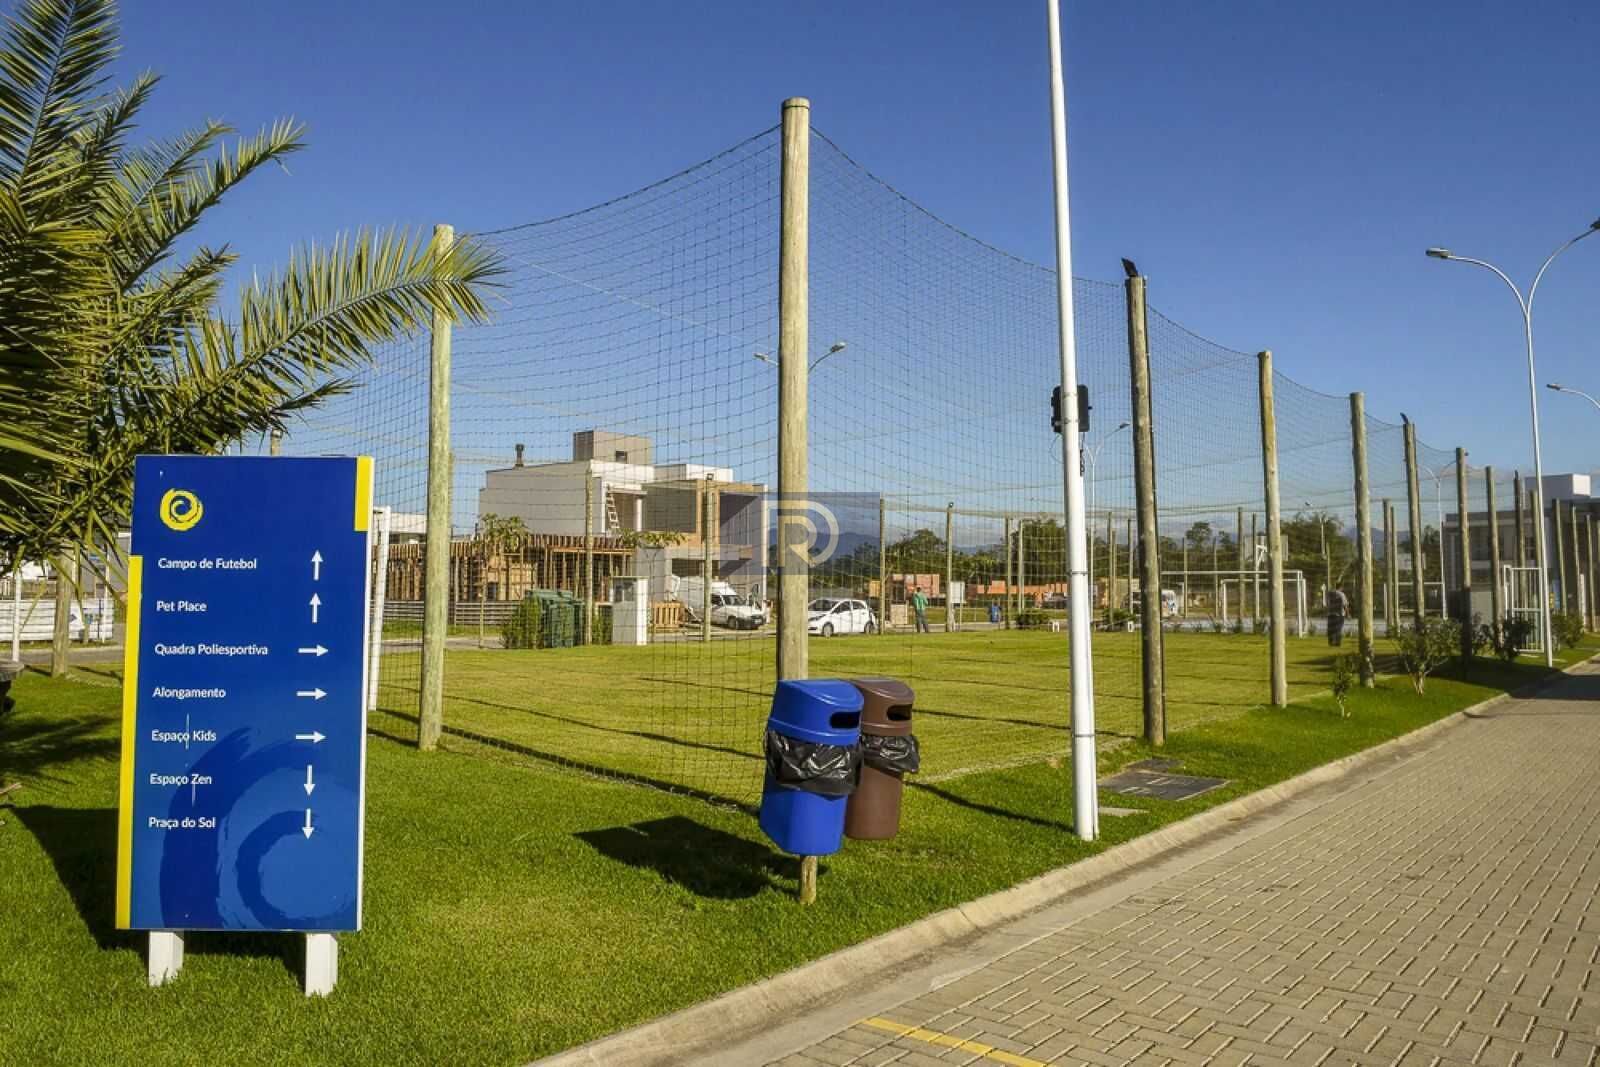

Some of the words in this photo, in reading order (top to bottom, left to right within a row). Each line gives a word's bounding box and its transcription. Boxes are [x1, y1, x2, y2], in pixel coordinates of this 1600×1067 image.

[157, 558, 197, 571] Campo
[199, 558, 213, 569] de
[215, 558, 257, 569] Futebol
[156, 600, 175, 612] Pet
[177, 600, 207, 612] Place
[154, 643, 195, 656] Quadra
[198, 643, 268, 657] Poliesportiva
[152, 687, 226, 700] Alongamento
[151, 729, 190, 743] Espaço
[193, 730, 217, 742] Kids
[150, 773, 189, 787] Espaço
[191, 773, 212, 785] Zen
[148, 817, 179, 830] Praça
[181, 817, 196, 828] do
[198, 817, 216, 828] Sol
